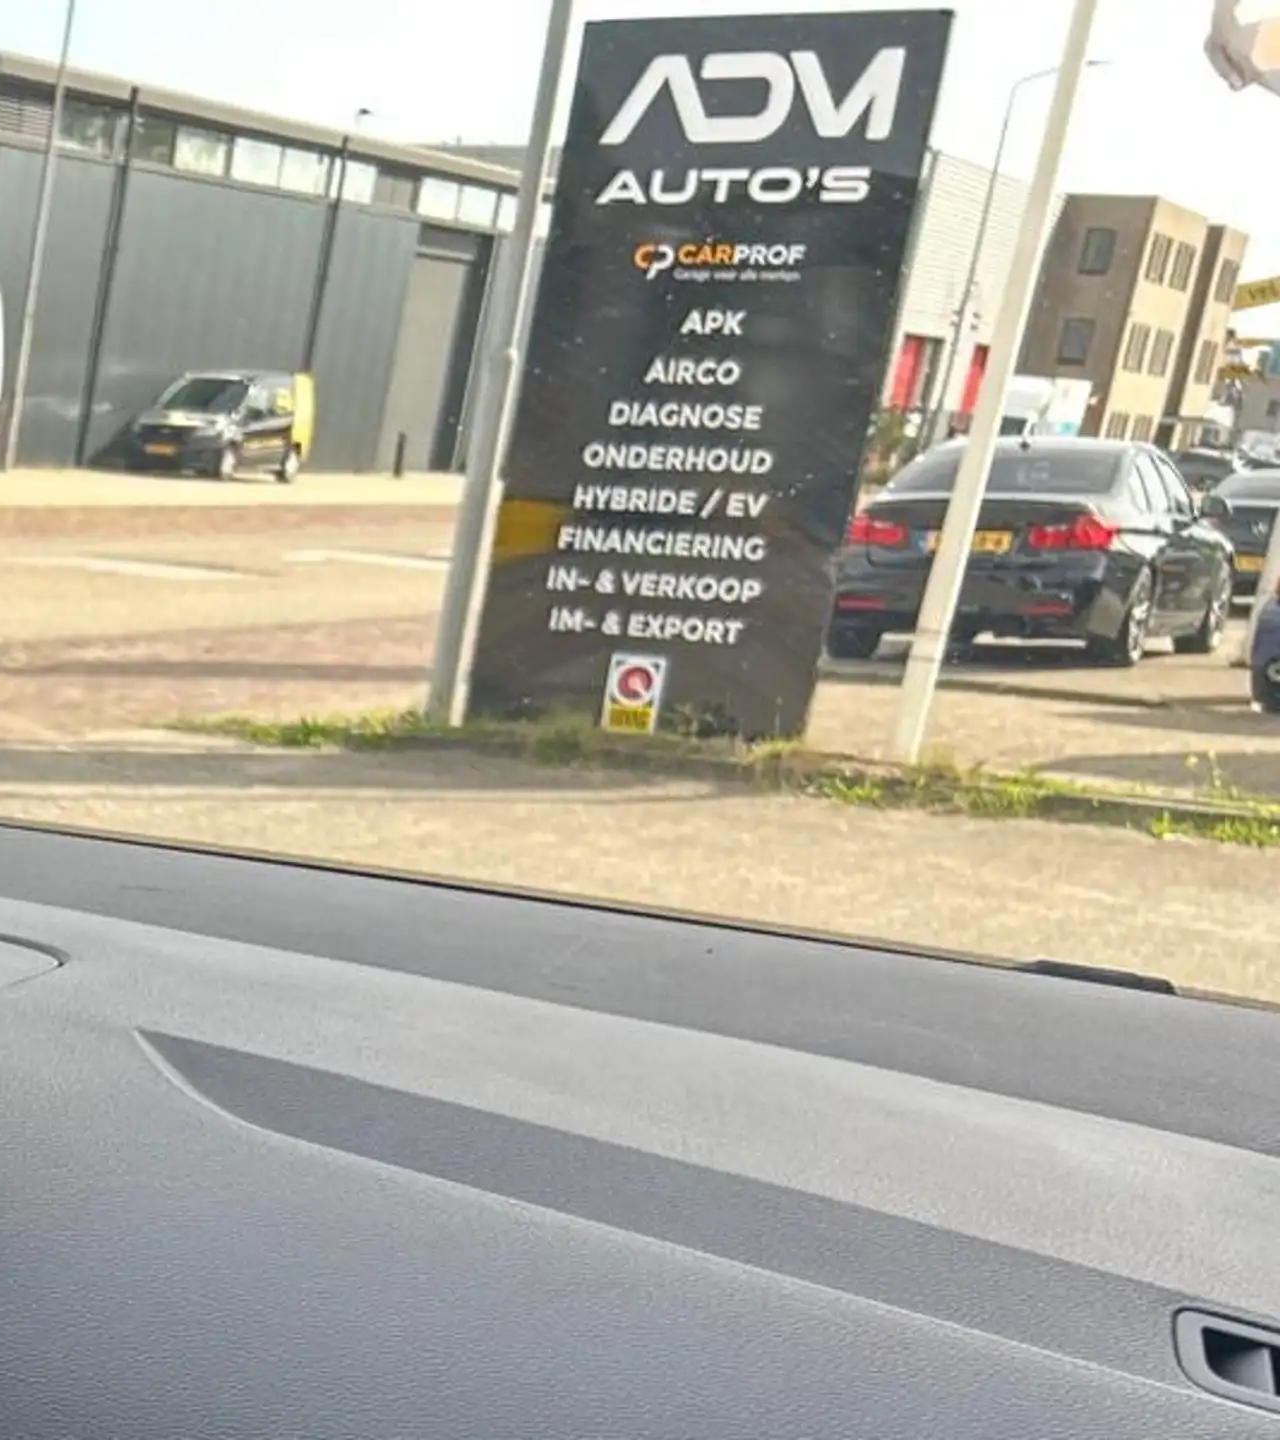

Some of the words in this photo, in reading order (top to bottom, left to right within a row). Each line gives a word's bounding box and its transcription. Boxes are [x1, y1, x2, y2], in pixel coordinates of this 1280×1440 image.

[598, 47, 907, 145] ADM
[595, 166, 872, 204] AUTO'S
[677, 242, 807, 266] CARPROF
[680, 309, 747, 336] APK
[644, 356, 742, 386] AIRCO
[608, 401, 764, 430] DIAGNOSE
[583, 443, 773, 475] ONDERHOUD
[573, 484, 698, 517] HYBRIDE
[725, 492, 769, 519] EV
[557, 525, 767, 562] FINANCIERING
[546, 565, 591, 592] IN-
[595, 569, 617, 595] &
[622, 571, 763, 604] VERKOOP
[548, 606, 596, 634] IM-
[601, 610, 622, 637] &
[627, 613, 745, 646] EXPORT
